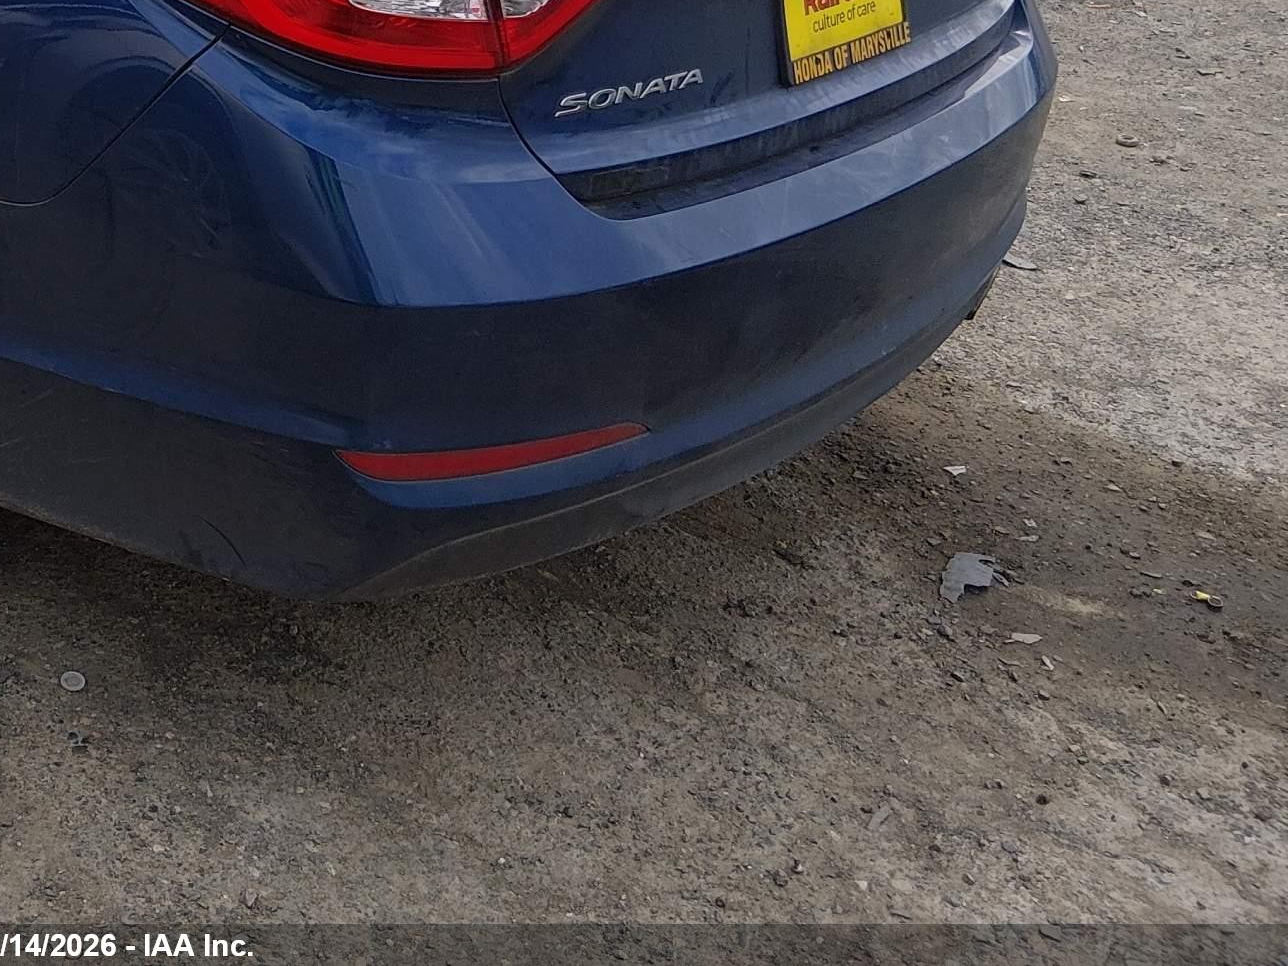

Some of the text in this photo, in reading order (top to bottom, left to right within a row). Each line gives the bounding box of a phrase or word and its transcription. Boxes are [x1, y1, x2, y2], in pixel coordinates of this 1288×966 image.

[812, 1, 876, 33] culture of care
[793, 21, 912, 84] HONDA OF MARYSVILLE
[554, 68, 704, 118] SONATA
